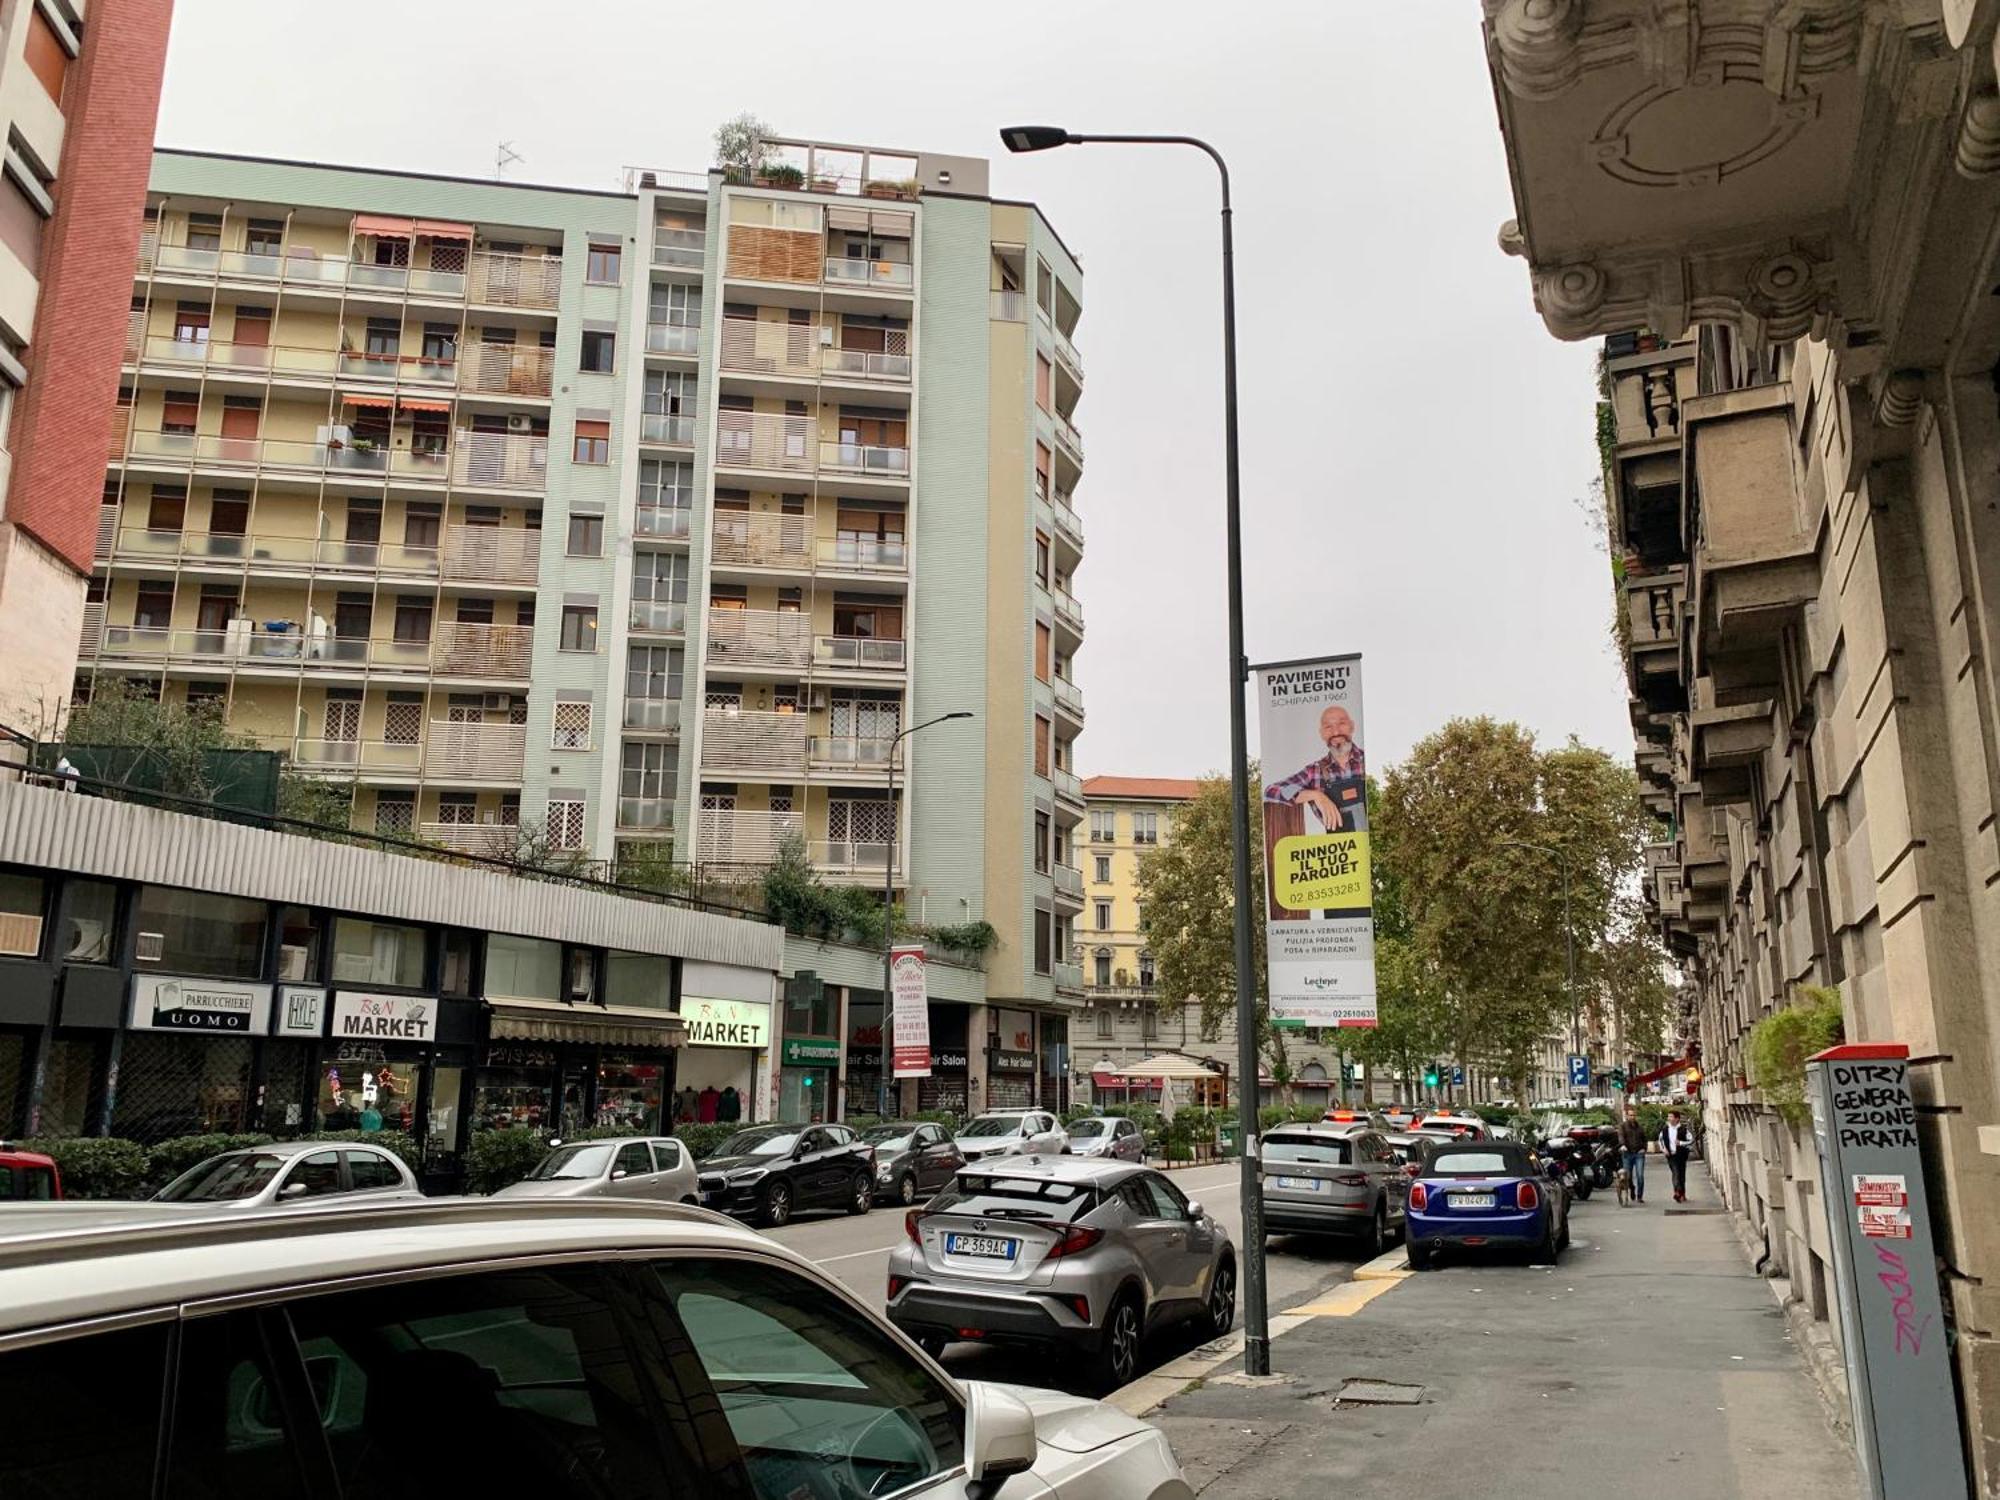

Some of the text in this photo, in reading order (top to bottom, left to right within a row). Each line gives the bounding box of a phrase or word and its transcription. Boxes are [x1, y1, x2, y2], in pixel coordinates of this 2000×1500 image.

[1267, 666, 1350, 686] PAVIMENTI
[1272, 679, 1346, 697] IN LEGNO
[1290, 839, 1357, 862] RINNOVA
[1299, 852, 1349, 871] IL TUO
[1290, 861, 1359, 885] PARQUET
[1289, 881, 1361, 904] 02 83533283
[185, 993, 250, 1009] PARRUCCHIERE
[171, 1013, 239, 1027] UOMO
[343, 1015, 429, 1038] MARKET
[687, 1020, 760, 1044] MARKET
[942, 1054, 966, 1066] Salon
[1572, 1058, 1585, 1073] P
[1834, 1088, 1910, 1110] GENERA
[1845, 1107, 1916, 1126] ZIONE
[1840, 1128, 1917, 1149] PIRATA
